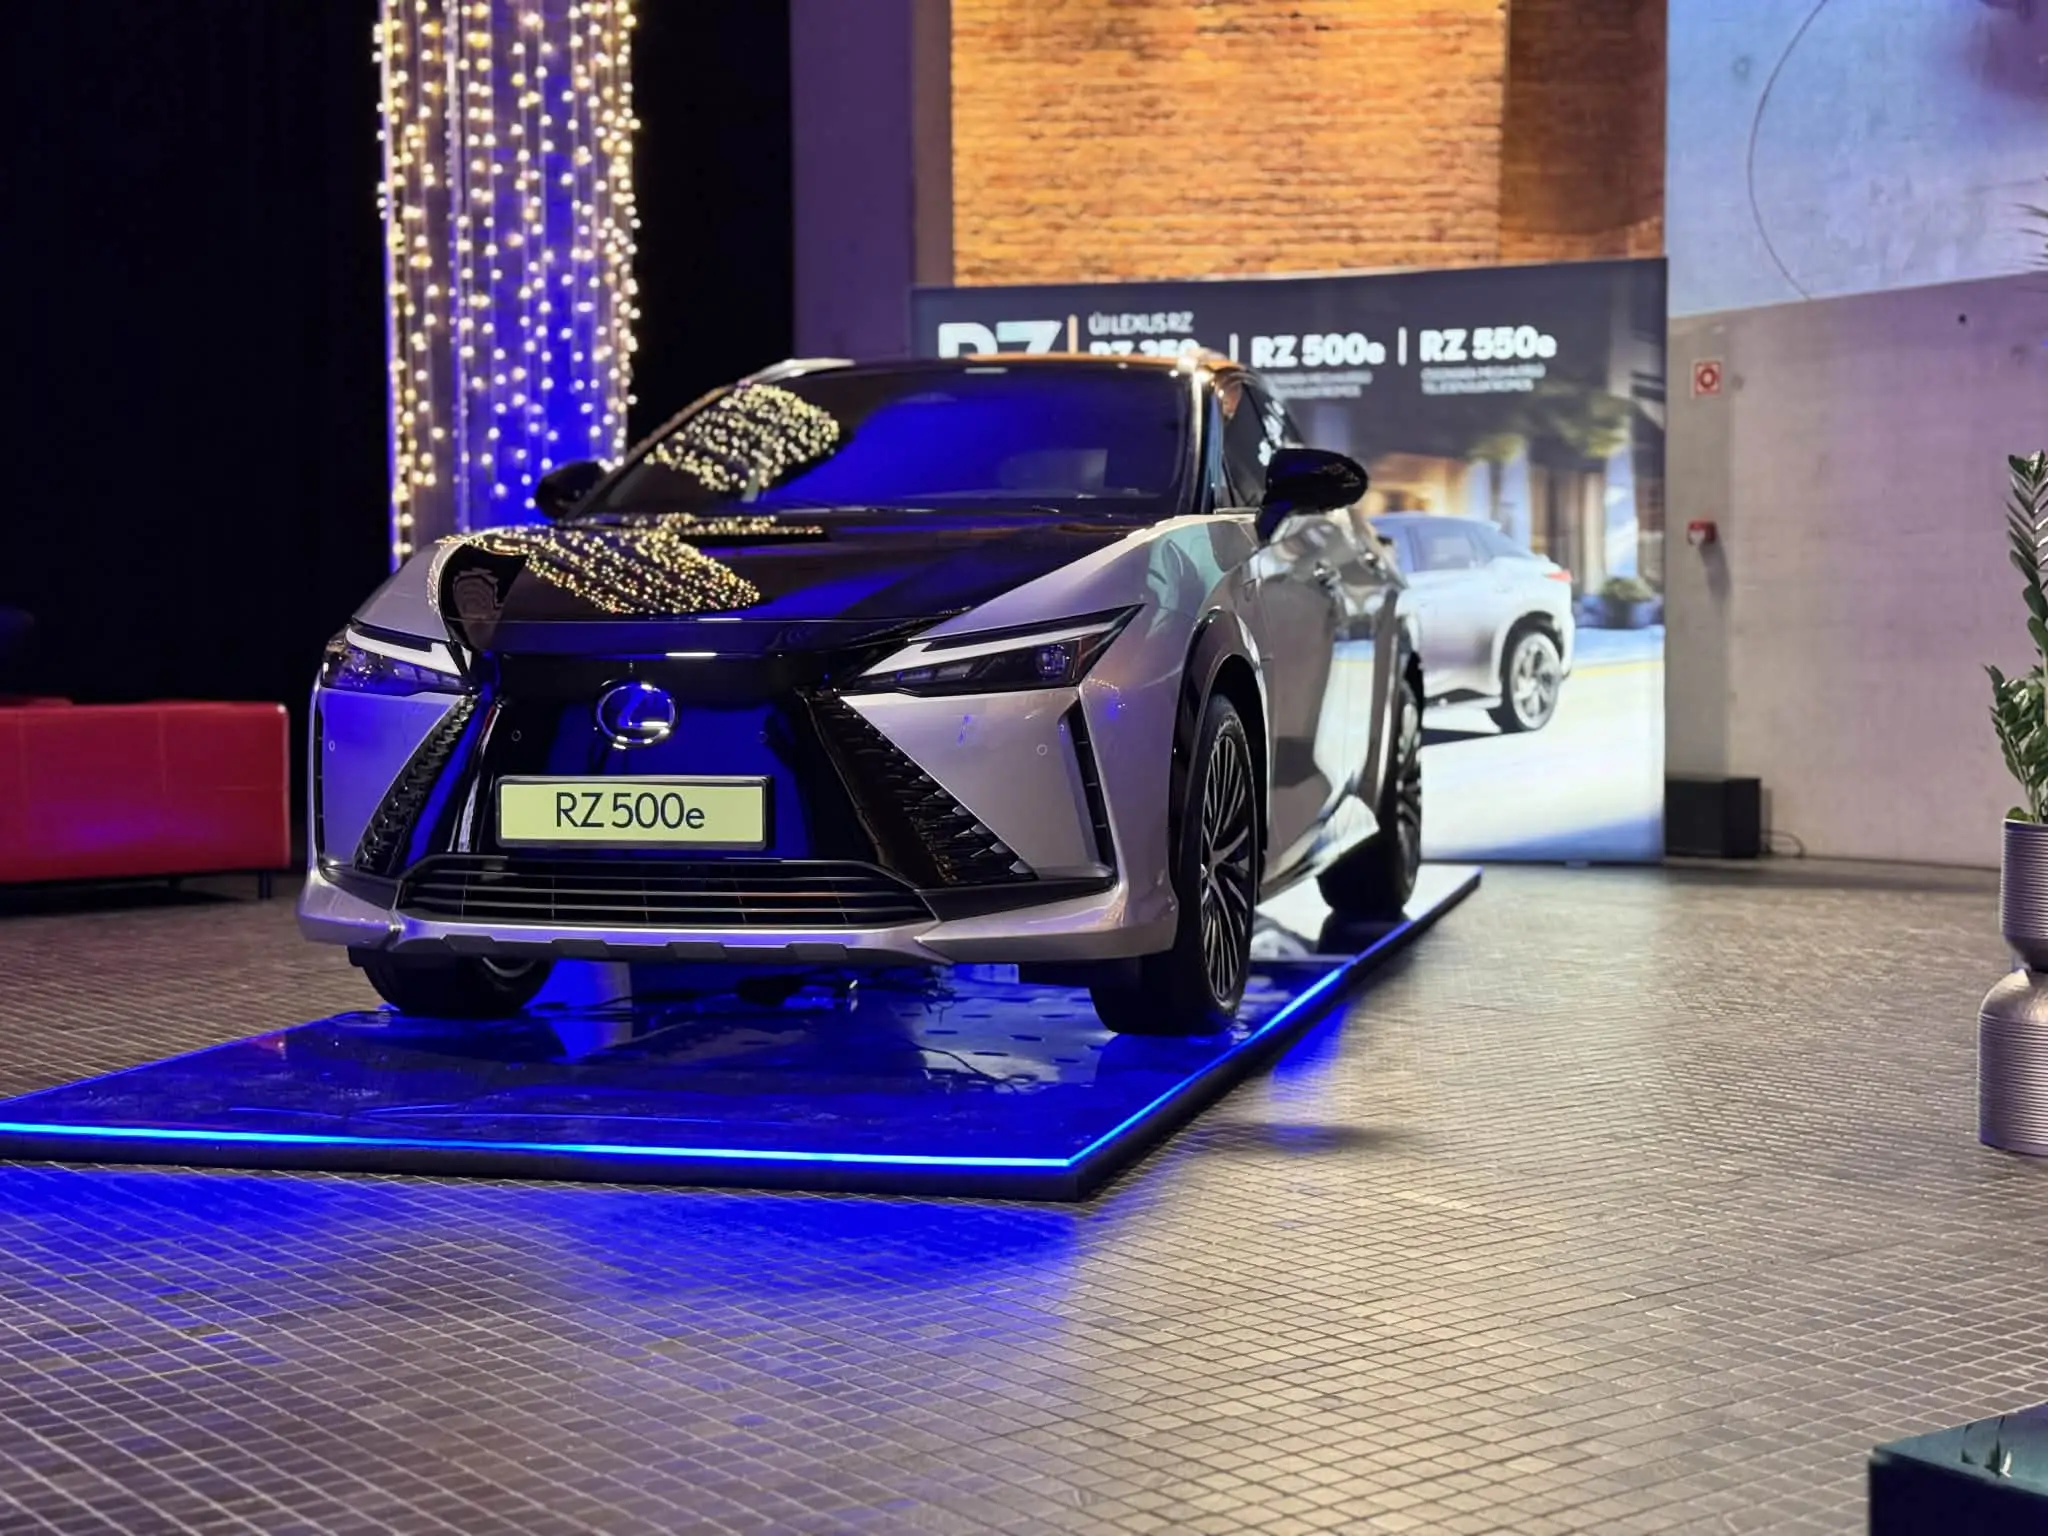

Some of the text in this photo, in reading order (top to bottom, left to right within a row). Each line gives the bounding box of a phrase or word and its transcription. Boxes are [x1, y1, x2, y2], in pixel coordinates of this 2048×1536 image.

[1251, 332, 1387, 368] RZ 500e
[1419, 325, 1558, 362] RZ 550e
[556, 791, 706, 829] RZ 500e
